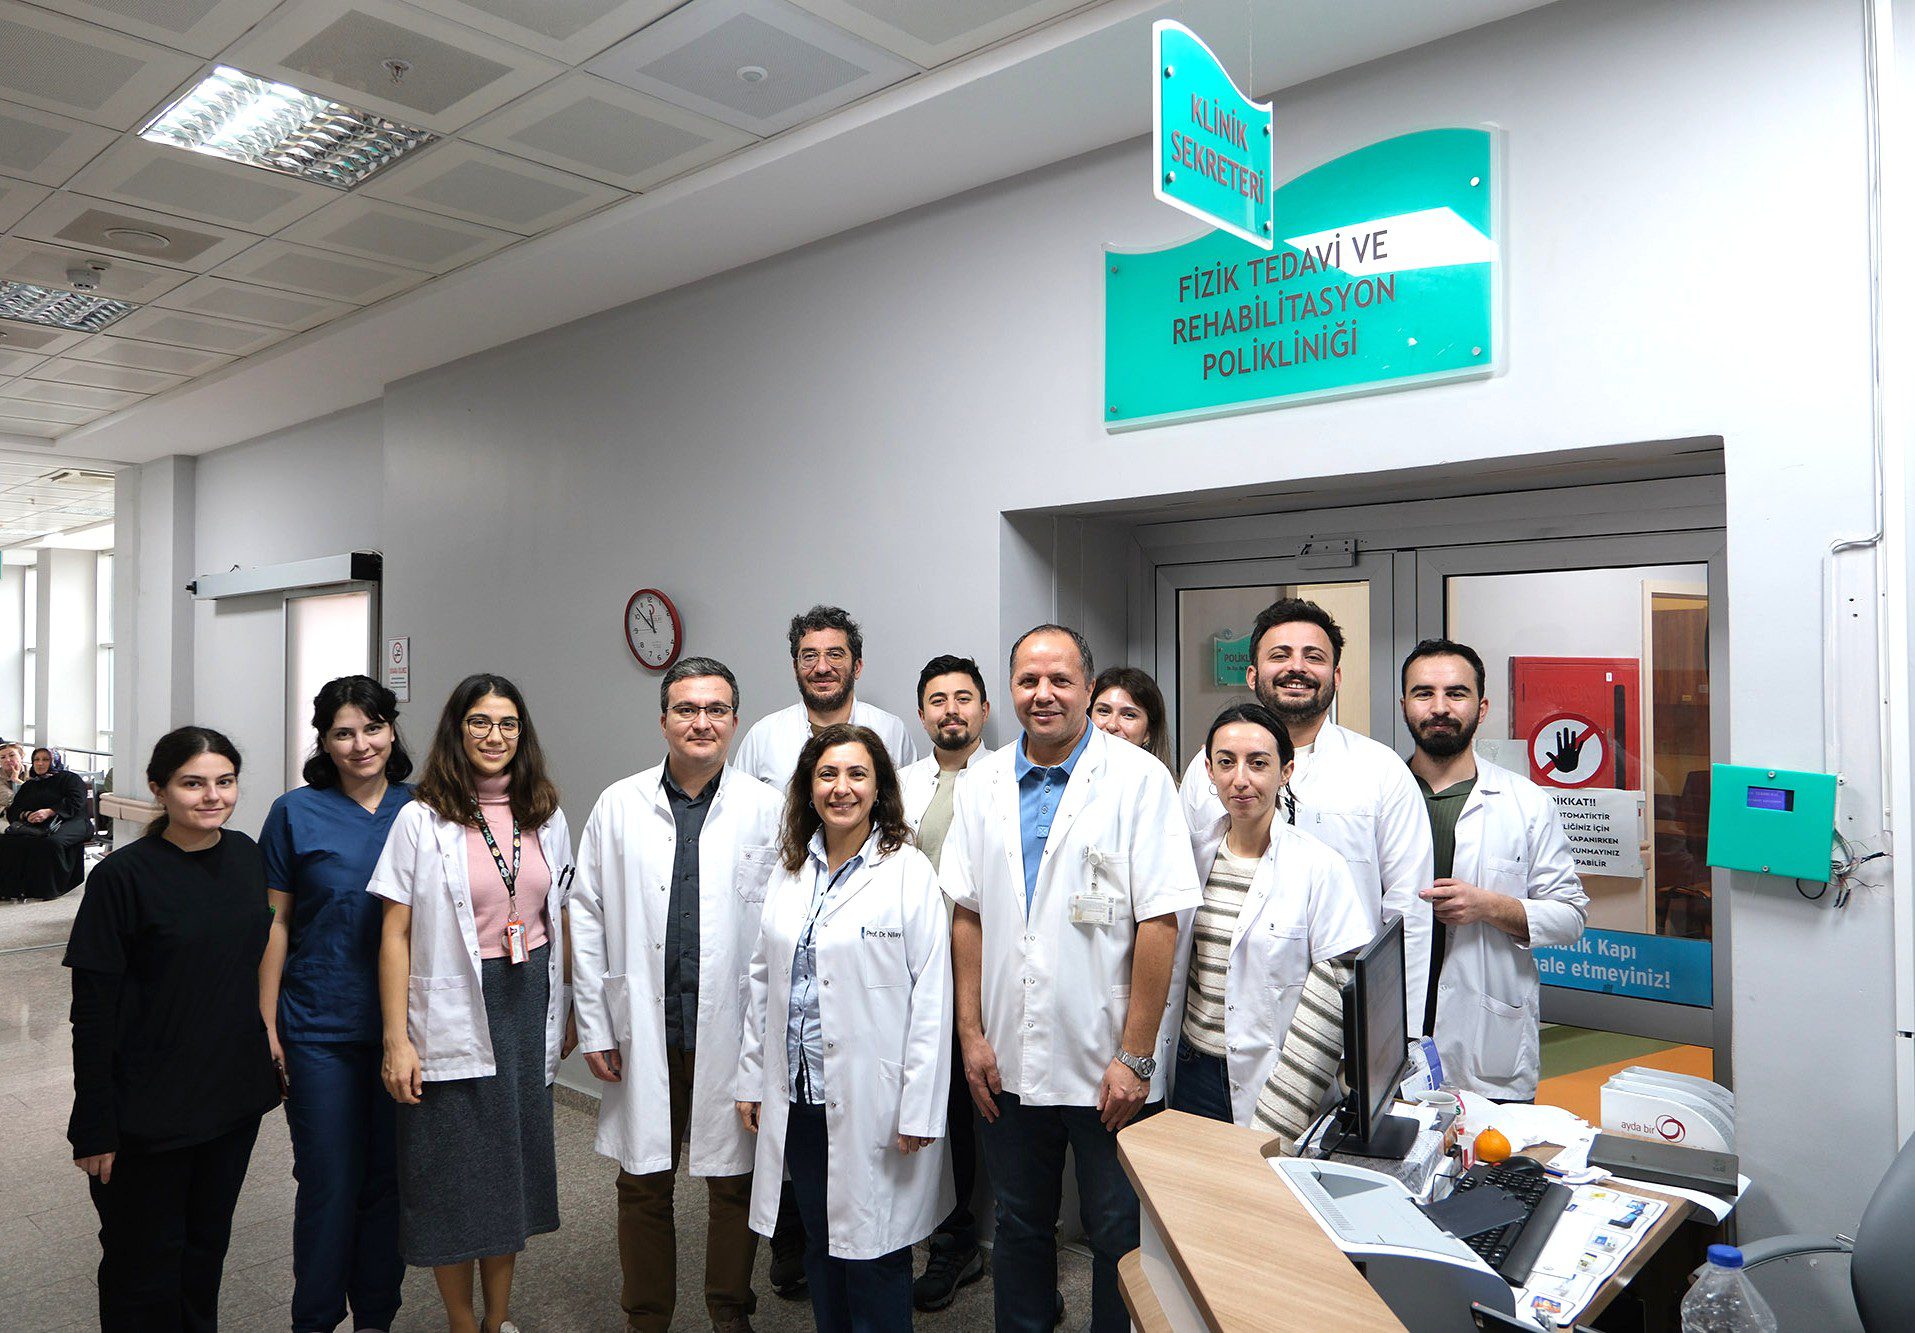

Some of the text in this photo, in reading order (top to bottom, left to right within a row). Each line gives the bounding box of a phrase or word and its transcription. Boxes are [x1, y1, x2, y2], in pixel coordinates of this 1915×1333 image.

[1191, 91, 1248, 152] KLİNİK
[1171, 129, 1265, 205] SEKRETERİ
[1178, 229, 1389, 303] FİZİK TEDAVİ VE
[1172, 273, 1396, 345] REHABİLİTASYON
[1202, 319, 1358, 380] POLİKLİNİĞİ
[1571, 960, 1671, 990] etmeyiniz!
[1598, 938, 1637, 962] Kapı
[1621, 1121, 1656, 1134] ayda bir
